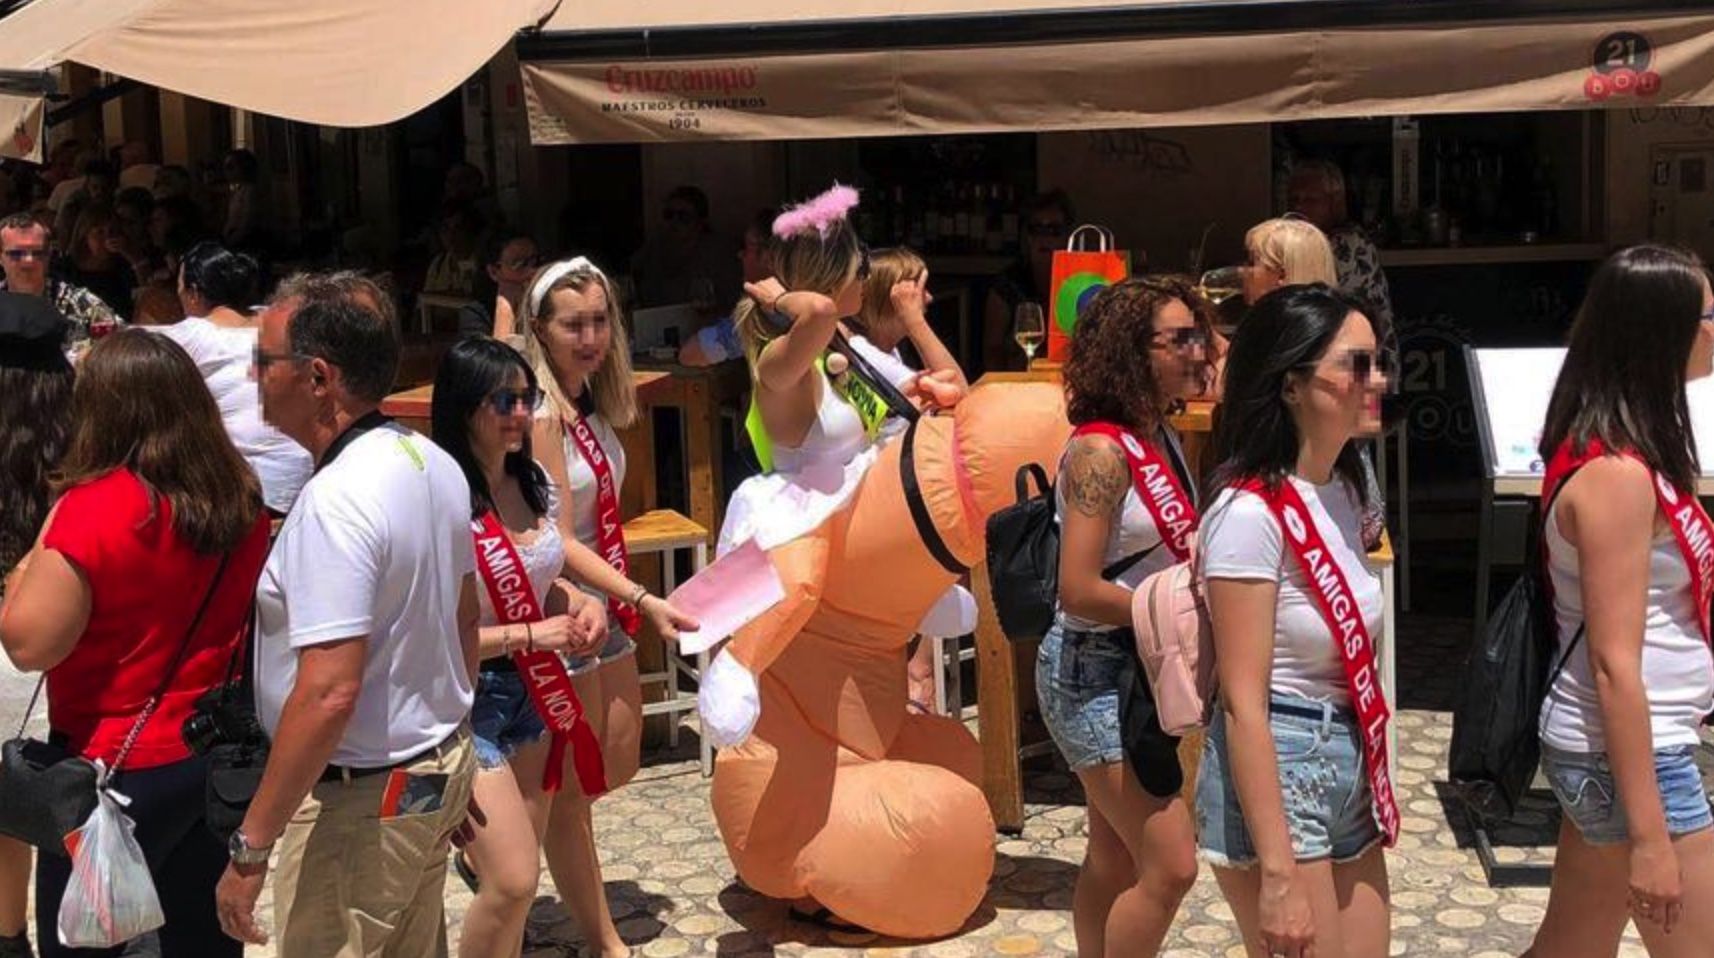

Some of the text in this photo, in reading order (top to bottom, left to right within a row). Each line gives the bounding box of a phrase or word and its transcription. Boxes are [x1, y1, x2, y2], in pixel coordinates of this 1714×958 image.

[1606, 40, 1636, 65] 21
[605, 65, 756, 95] Cruzcampo
[601, 97, 767, 113] MAESTROS CERVECEROS
[668, 117, 701, 130] 1904
[1404, 351, 1447, 392] 21
[1139, 463, 1194, 550] AMIGAS
[601, 507, 617, 539] LA
[477, 537, 532, 621] AMIGAS
[1303, 547, 1363, 660] AMIGAS
[1353, 664, 1376, 713] DE
[1368, 713, 1385, 760] LA
[528, 661, 559, 689] LA
